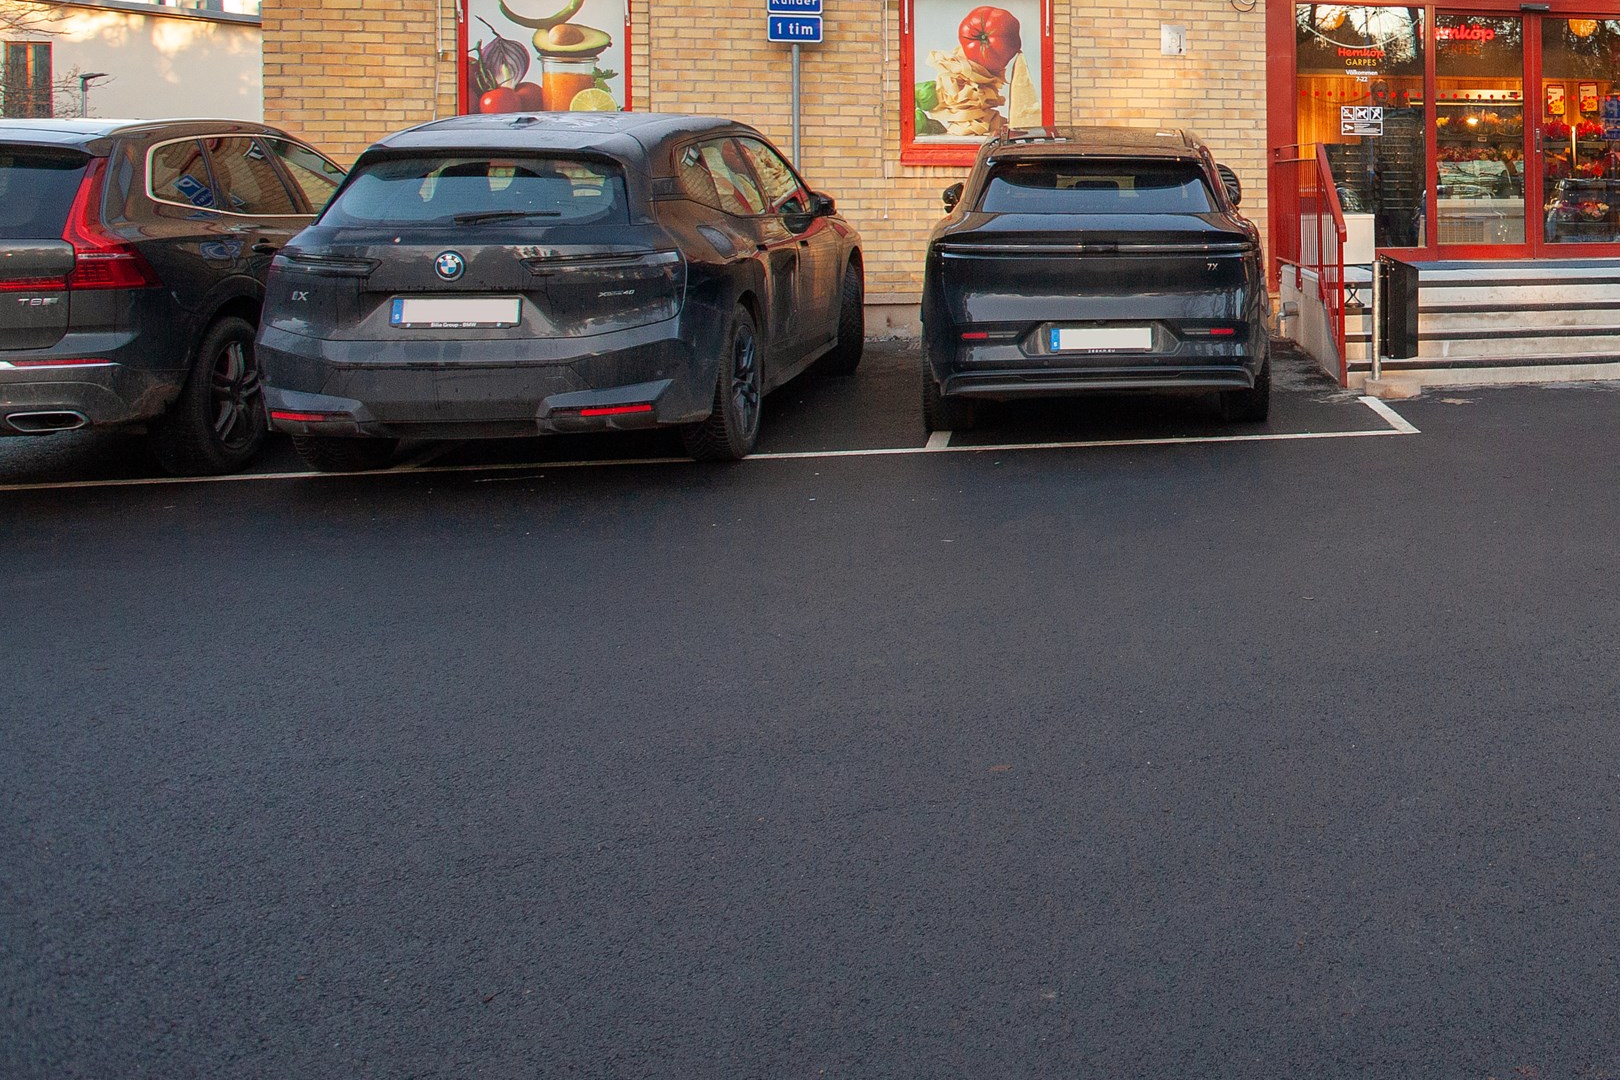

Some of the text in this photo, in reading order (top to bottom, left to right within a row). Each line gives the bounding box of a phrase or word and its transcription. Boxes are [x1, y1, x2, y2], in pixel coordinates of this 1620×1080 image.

[777, 22, 813, 35] 1 tim
[1338, 47, 1385, 59] Hemköp
[1345, 58, 1377, 66] GARPES
